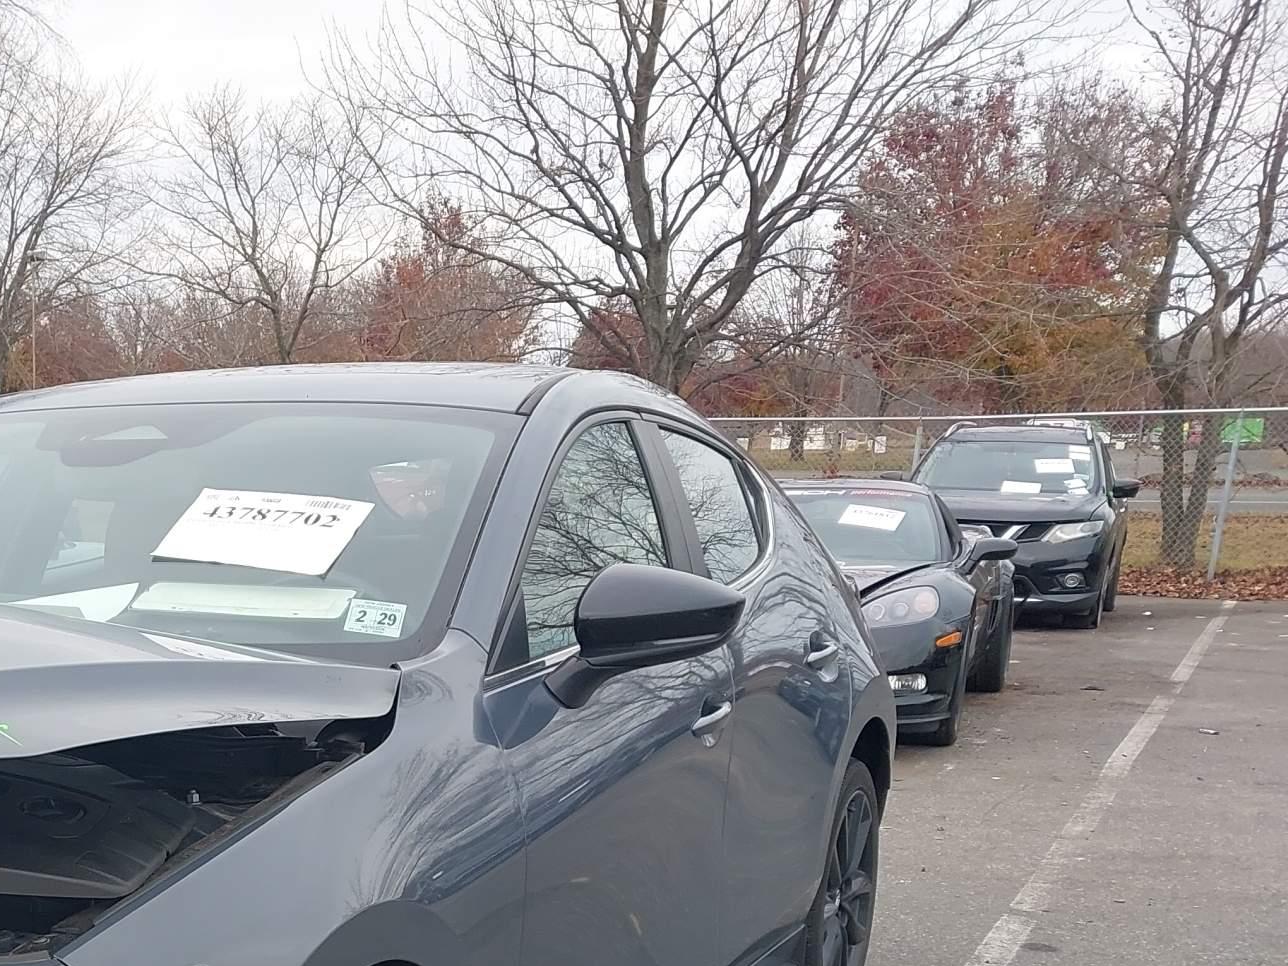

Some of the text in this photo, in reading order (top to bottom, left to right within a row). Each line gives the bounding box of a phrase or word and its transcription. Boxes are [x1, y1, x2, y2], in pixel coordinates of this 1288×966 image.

[203, 506, 341, 528] 43787702
[355, 610, 368, 623] 2
[377, 612, 397, 626] 29
